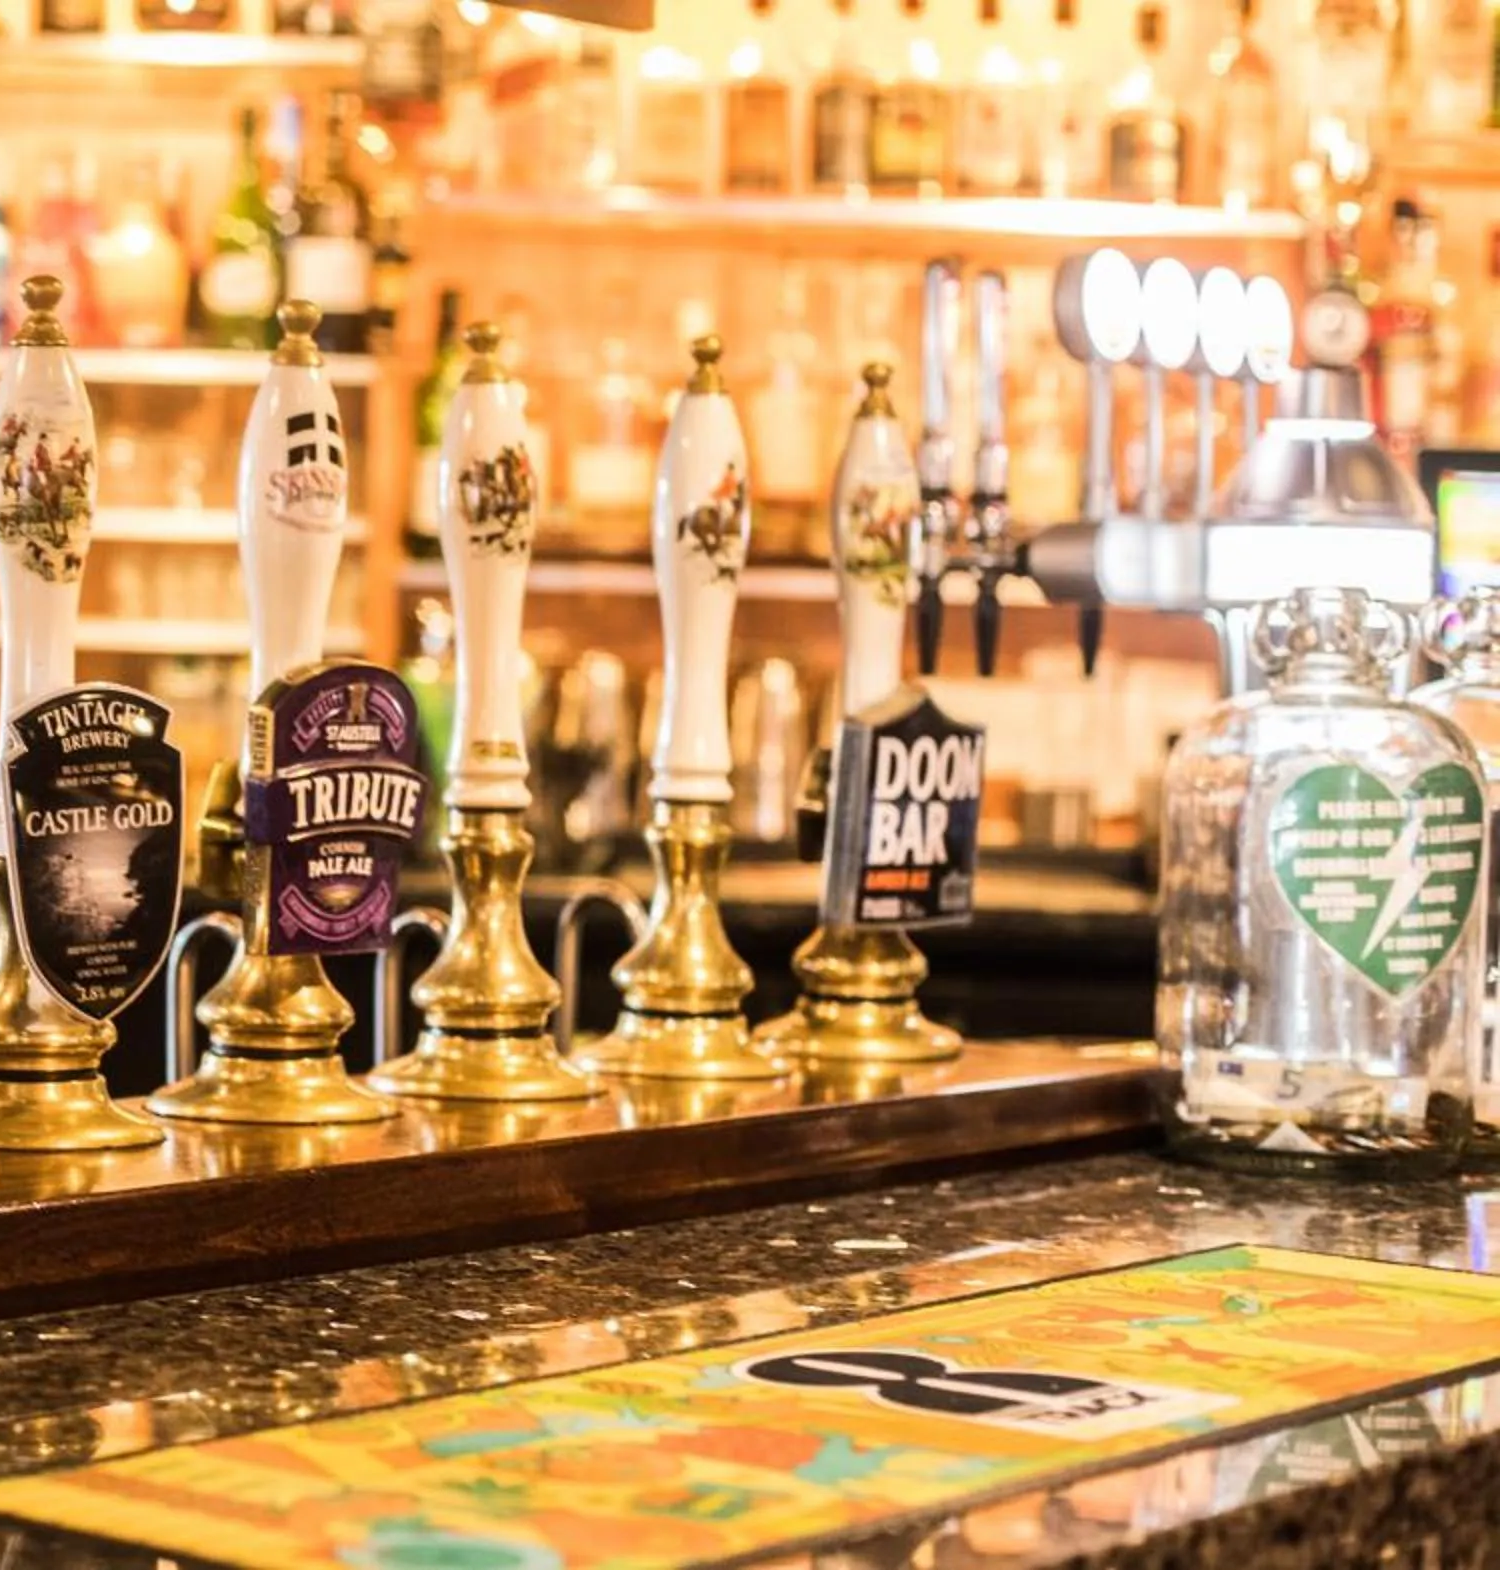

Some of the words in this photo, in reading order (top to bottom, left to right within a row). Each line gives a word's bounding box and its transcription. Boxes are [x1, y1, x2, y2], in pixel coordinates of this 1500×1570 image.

[37, 701, 151, 738] TINTAGE
[61, 730, 131, 753] BREWERY
[874, 734, 984, 802] DOOM
[25, 805, 108, 838] CASTLE
[113, 800, 174, 831] GOLD
[287, 772, 421, 829] TRIBUTE
[866, 801, 949, 867] BAR
[308, 856, 345, 878] PALE
[345, 856, 374, 876] ALE
[1277, 1069, 1301, 1099] 5
